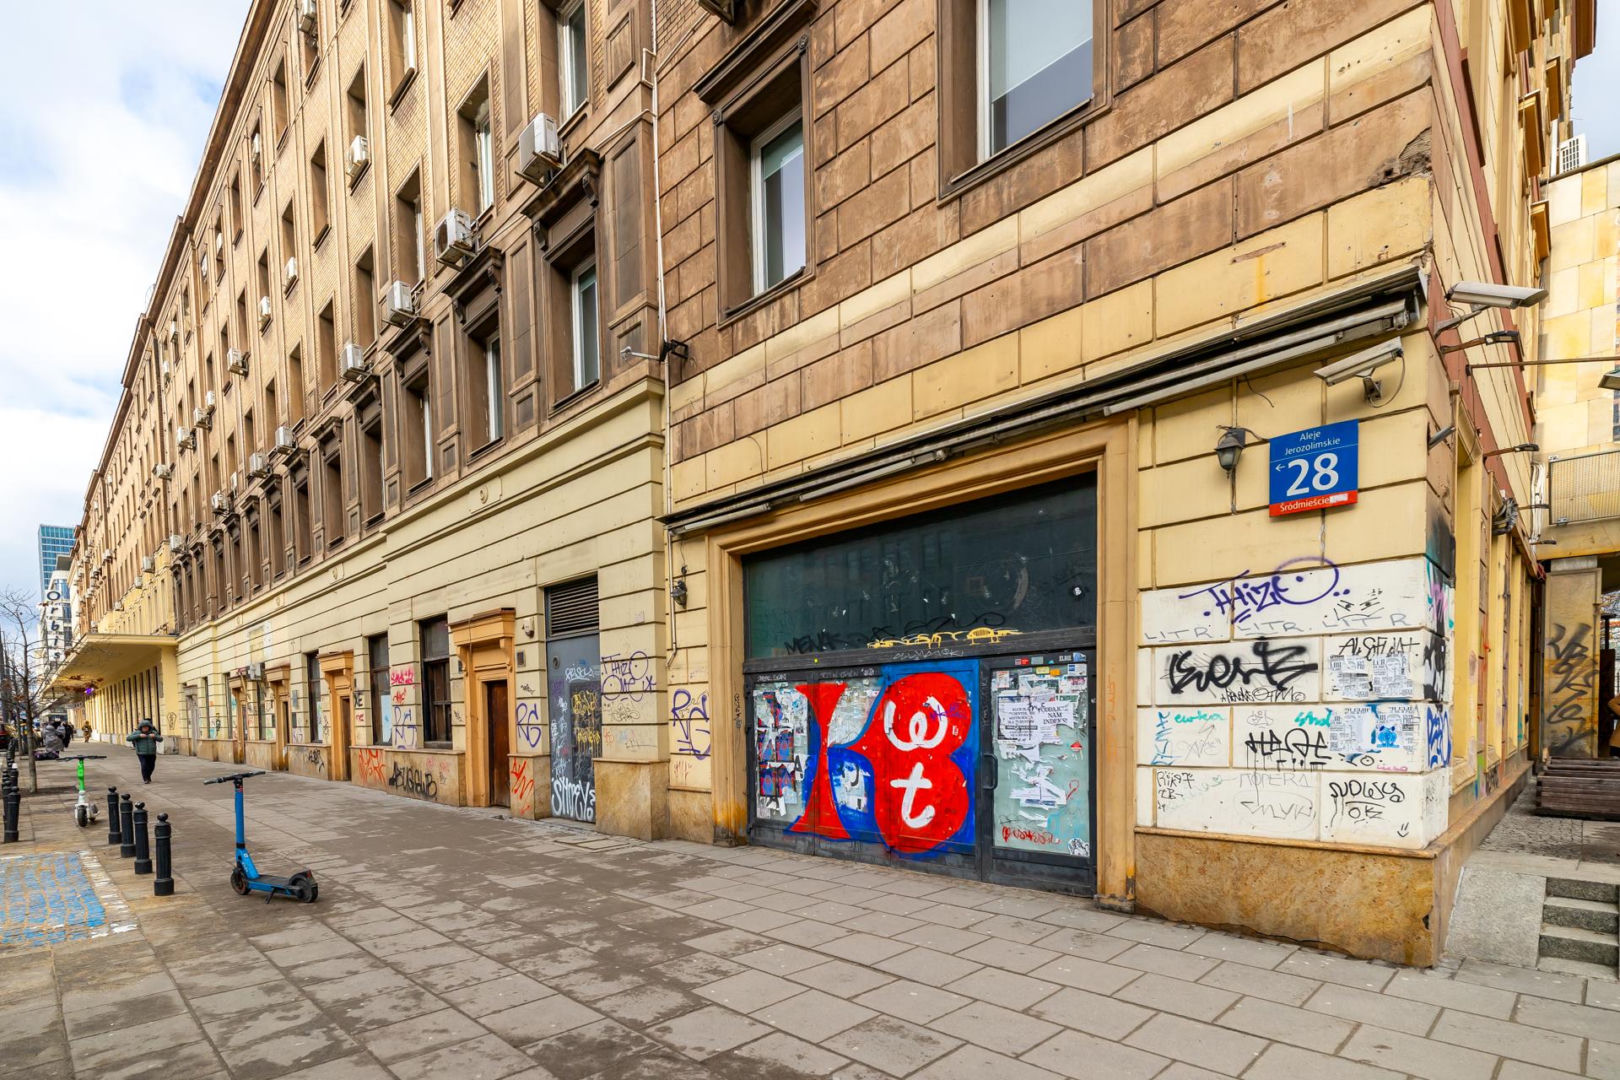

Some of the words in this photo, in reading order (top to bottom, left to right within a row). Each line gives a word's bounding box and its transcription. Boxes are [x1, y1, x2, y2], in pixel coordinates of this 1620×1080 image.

[1300, 431, 1321, 441] Aleje
[1285, 437, 1341, 455] Jerozolimskie
[1286, 452, 1339, 497] 28
[1280, 496, 1330, 512] Śródmieście
[47, 591, 61, 659] Orbis
